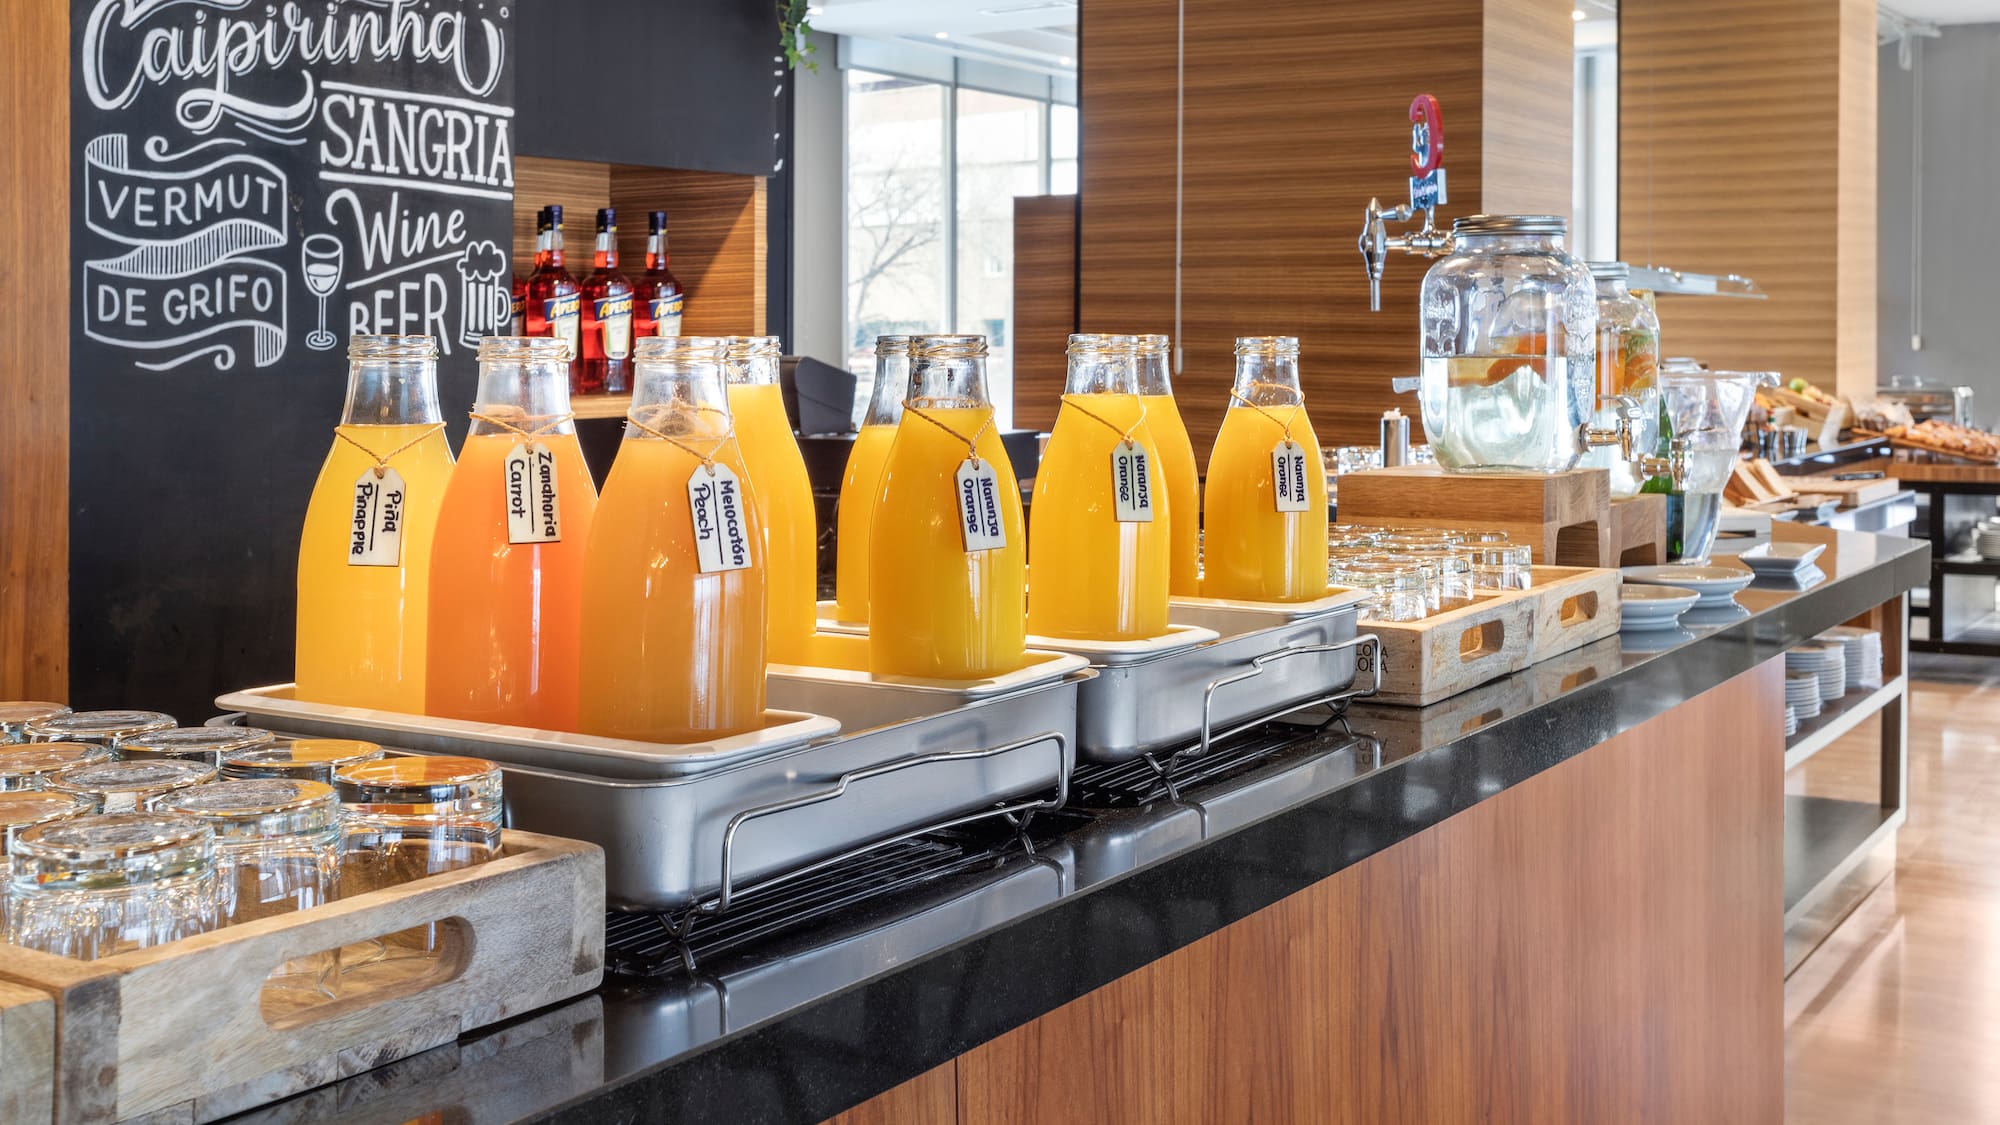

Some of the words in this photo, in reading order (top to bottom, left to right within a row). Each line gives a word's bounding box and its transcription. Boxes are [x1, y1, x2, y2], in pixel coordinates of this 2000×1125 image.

[82, 0, 507, 132] Caipirinha
[319, 94, 514, 187] SANGRIA
[98, 174, 277, 228] VERMUT
[325, 188, 466, 271] Wine
[97, 284, 147, 327] DE
[162, 274, 273, 326] GRIFO
[349, 273, 452, 356] BEER
[510, 458, 526, 519] Carrot
[538, 451, 557, 537] Zanahoria
[963, 478, 978, 534] Orange
[1118, 456, 1130, 503] Orange
[1135, 455, 1149, 509] Naranja
[1277, 456, 1288, 498] Orange
[1294, 456, 1305, 502] Naranja
[351, 482, 373, 555] Pinapple
[382, 490, 402, 532] Piña
[694, 483, 713, 540] Peach
[720, 480, 745, 565] Melocotón
[980, 477, 999, 536] Naranja
